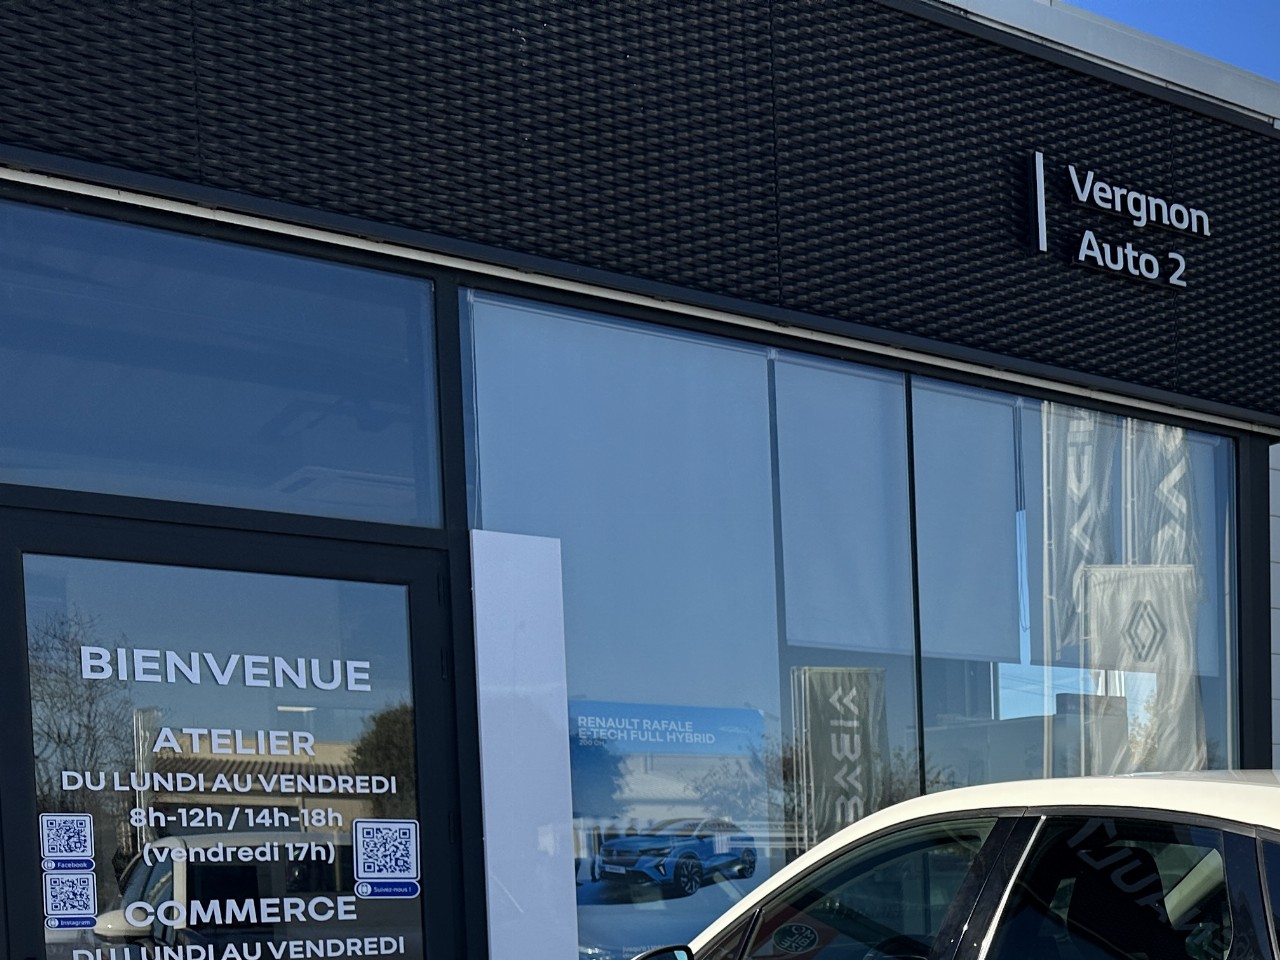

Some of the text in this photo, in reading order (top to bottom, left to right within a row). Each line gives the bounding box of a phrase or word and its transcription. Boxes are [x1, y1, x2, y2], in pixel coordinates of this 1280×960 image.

[1067, 164, 1211, 237] Vergnon
[1078, 229, 1187, 288] Auto 2
[80, 645, 371, 692] BIENVENUE
[578, 716, 693, 732] RENAULT RAFALE
[578, 728, 715, 744] E-TECH FULL HYBRID
[152, 726, 316, 757] ATELIER
[61, 771, 397, 795] DU LUNDI AU VENDREDI
[129, 807, 224, 828] 8h-12h
[245, 806, 343, 828] 14h-18h
[142, 841, 337, 868] (vendredi 17h)
[60, 919, 91, 928] Instagram
[124, 895, 358, 928] COMMERCE
[266, 936, 405, 960] VENDREDI
